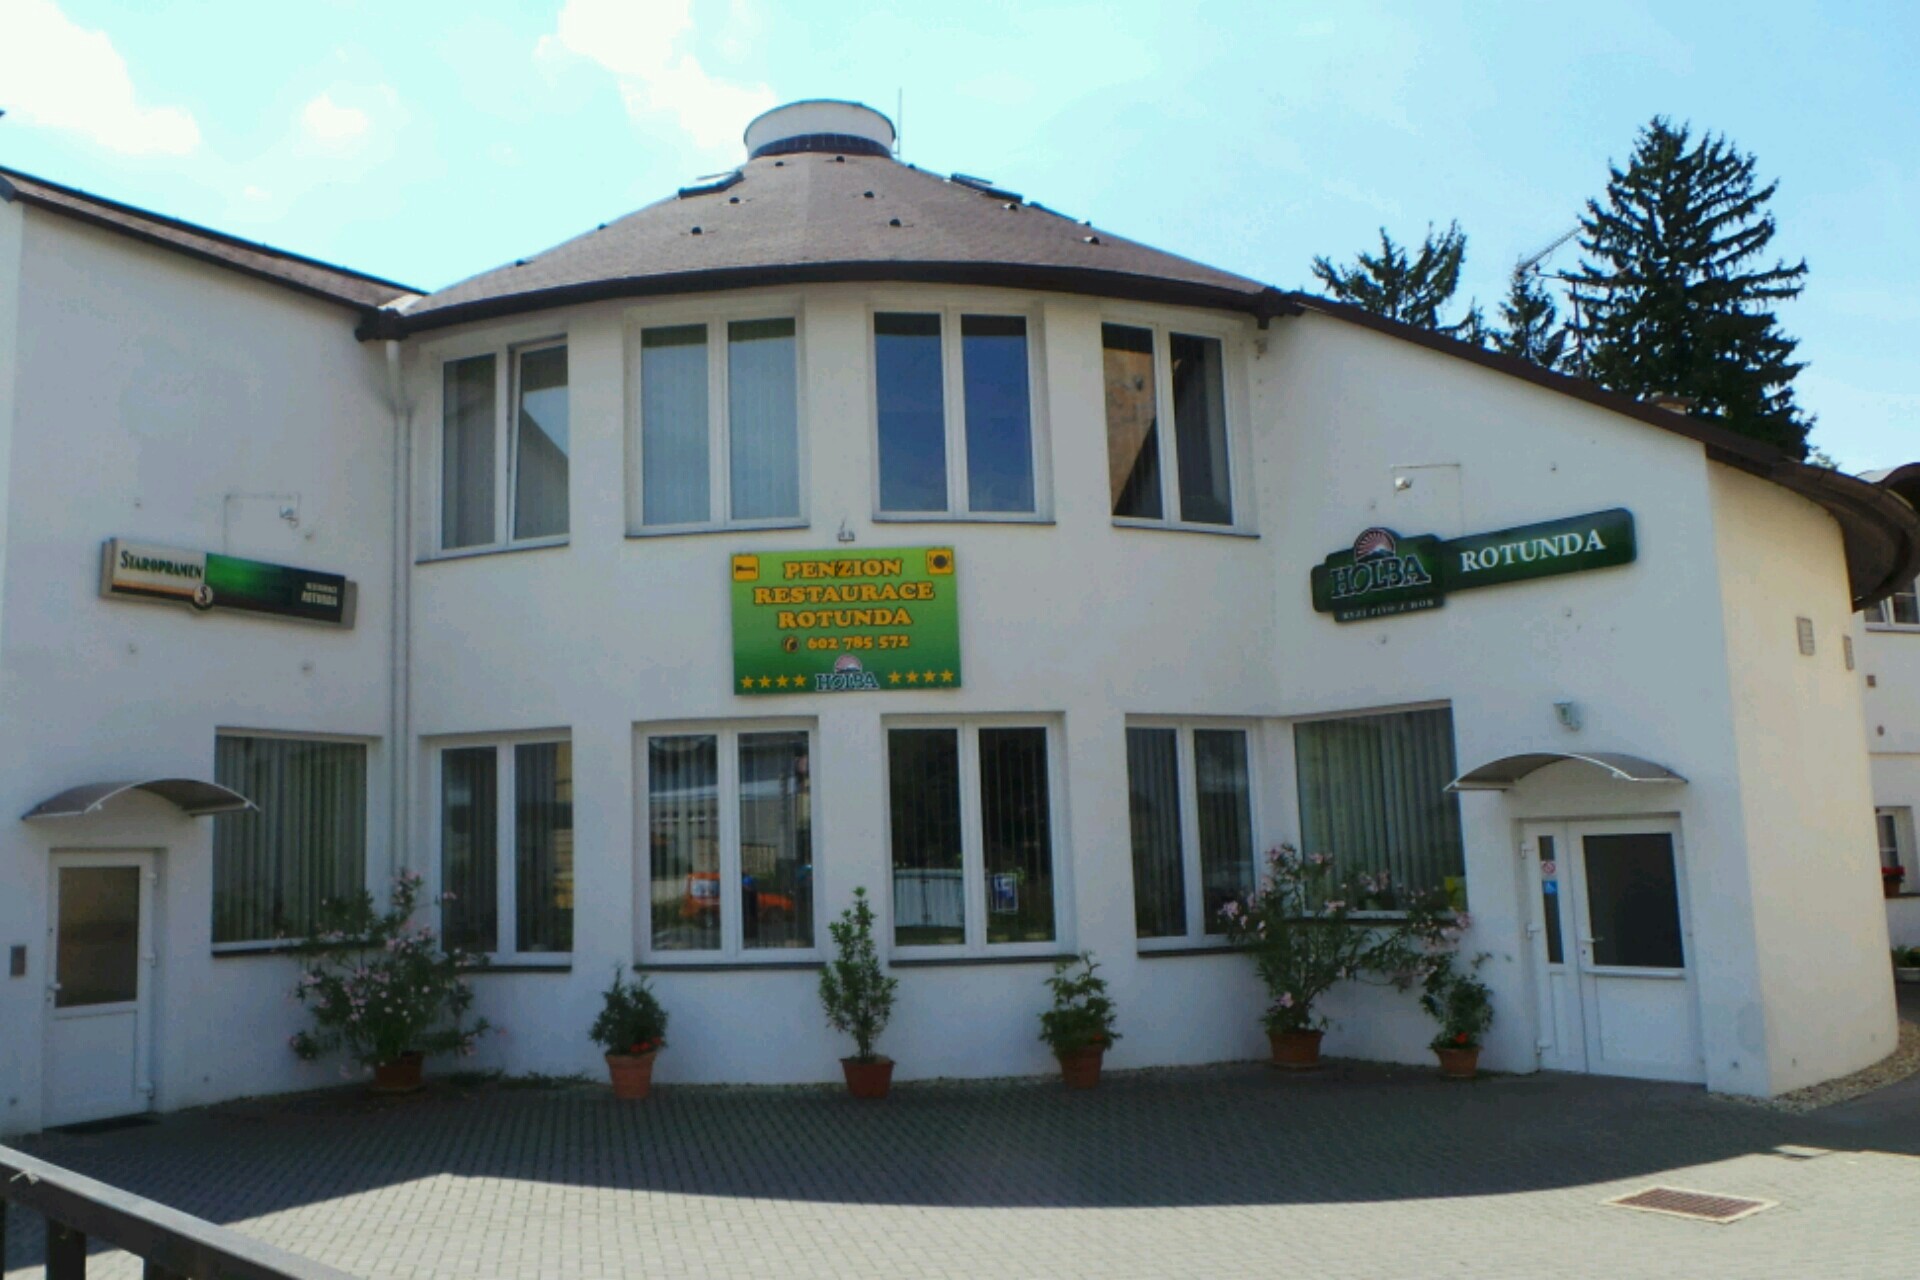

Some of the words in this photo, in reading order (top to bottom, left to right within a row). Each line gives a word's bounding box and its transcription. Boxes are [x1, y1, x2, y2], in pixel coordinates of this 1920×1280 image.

[1460, 529, 1606, 572] ROTUNDA
[784, 559, 902, 579] PENZION
[1330, 554, 1432, 599] HOLBA
[754, 582, 935, 604] RESTAURACE
[778, 608, 912, 629] ROTUNDA
[807, 637, 839, 650] 602
[843, 636, 873, 650] 785
[878, 635, 909, 648] 572
[815, 673, 880, 692] HOLBA
